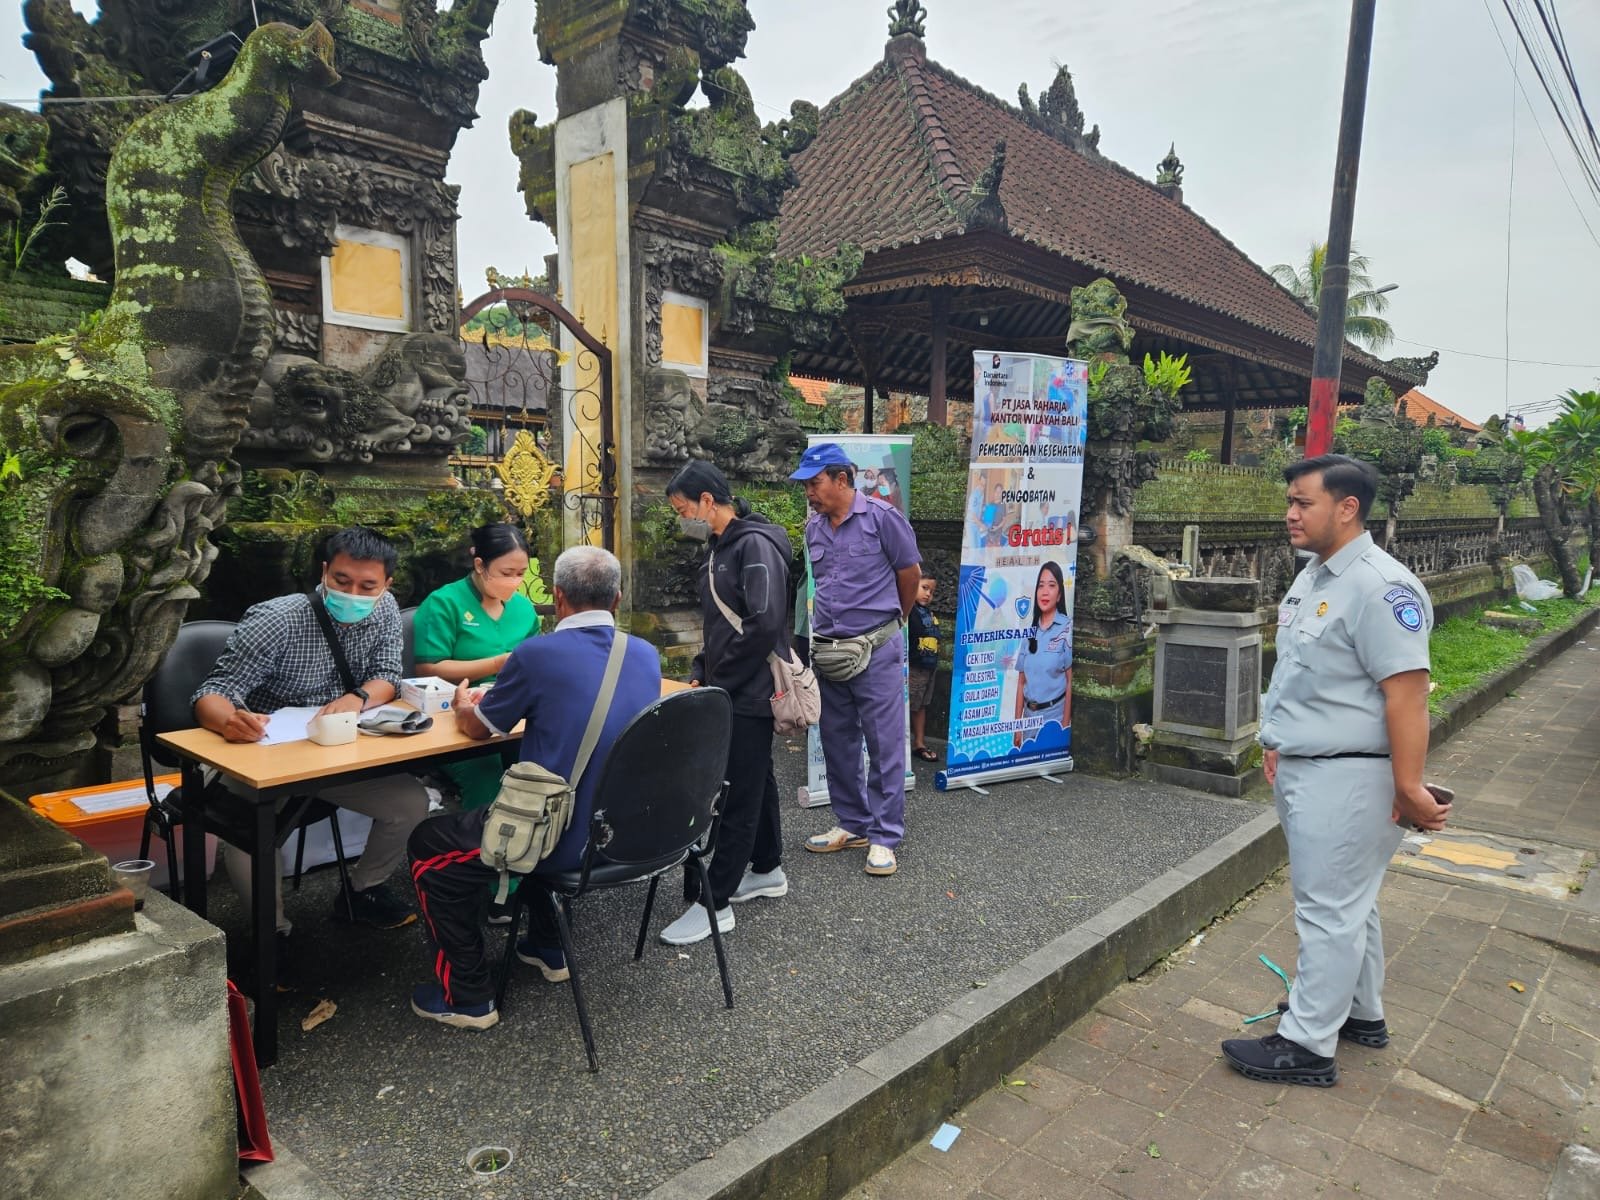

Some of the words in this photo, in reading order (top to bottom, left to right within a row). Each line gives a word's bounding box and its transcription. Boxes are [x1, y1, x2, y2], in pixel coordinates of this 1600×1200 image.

[1001, 398, 1011, 410] PT
[1012, 399, 1031, 412] JASA
[1033, 400, 1068, 414] RAHARJA
[990, 412, 1023, 425] KANTOR
[1023, 413, 1061, 426] WILAYAH
[1061, 415, 1078, 426] BALI
[978, 442, 1037, 457] PEMERIKSAAN
[1038, 443, 1083, 458] KESEHATAN
[1027, 466, 1036, 480] &
[1000, 489, 1056, 504] PENGOBATAN
[961, 627, 1037, 645] PEMERIKSAAN
[967, 653, 979, 666] CEK
[965, 691, 980, 702] GULA
[980, 687, 999, 701] DARAH
[963, 708, 981, 721] ASAM
[981, 705, 996, 719] URAT
[962, 724, 990, 739] MASALAH
[989, 719, 1024, 734] KESEHATAN
[1024, 716, 1043, 729] LAINYA
